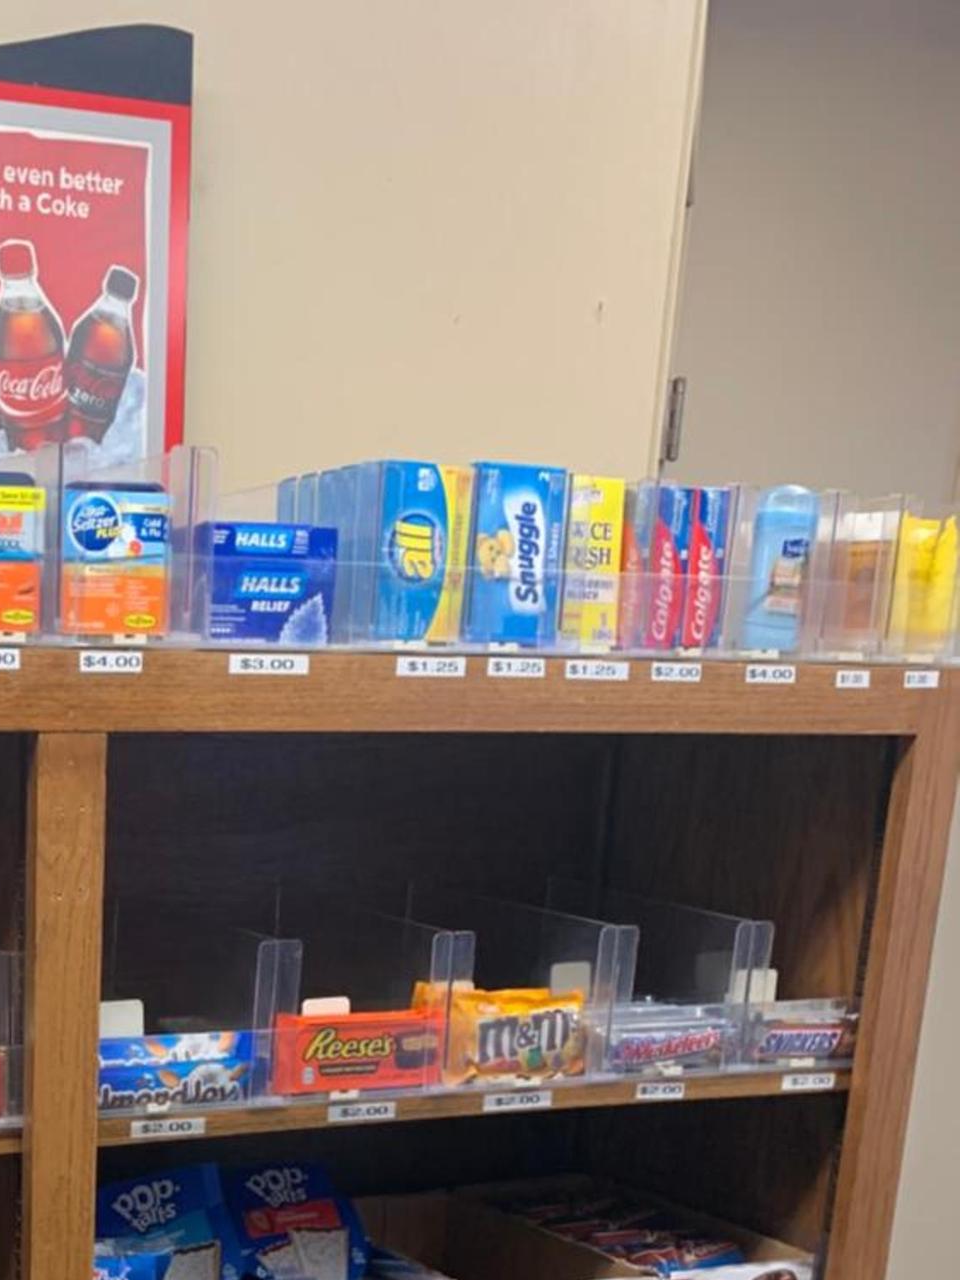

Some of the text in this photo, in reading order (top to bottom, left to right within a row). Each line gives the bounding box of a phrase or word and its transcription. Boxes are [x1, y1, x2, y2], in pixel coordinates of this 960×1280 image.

[3, 165, 54, 189] even
[59, 166, 124, 196] better
[18, 192, 31, 212] a
[37, 193, 90, 219] Coke
[235, 531, 288, 548] HALLS
[395, 520, 432, 580] all
[515, 501, 541, 604] Snuggle
[241, 576, 302, 594] HALLS
[651, 540, 674, 642] Colgate
[691, 544, 714, 642] Colgate
[251, 600, 291, 613] RELIEF
[83, 656, 141, 668] $4.00
[240, 658, 295, 671] $3.00
[408, 661, 459, 673] $1.25
[493, 661, 543, 673] $1.25
[569, 664, 617, 675] $1.25
[653, 667, 700, 679] $2.00
[748, 668, 793, 680] $4.00
[304, 1027, 395, 1062] Reese's
[761, 1030, 840, 1054] SNICKERS
[98, 1079, 191, 1109] lmond
[494, 1094, 541, 1107] $2.00
[342, 1105, 389, 1117] $2.00
[141, 1121, 193, 1135] $2.00
